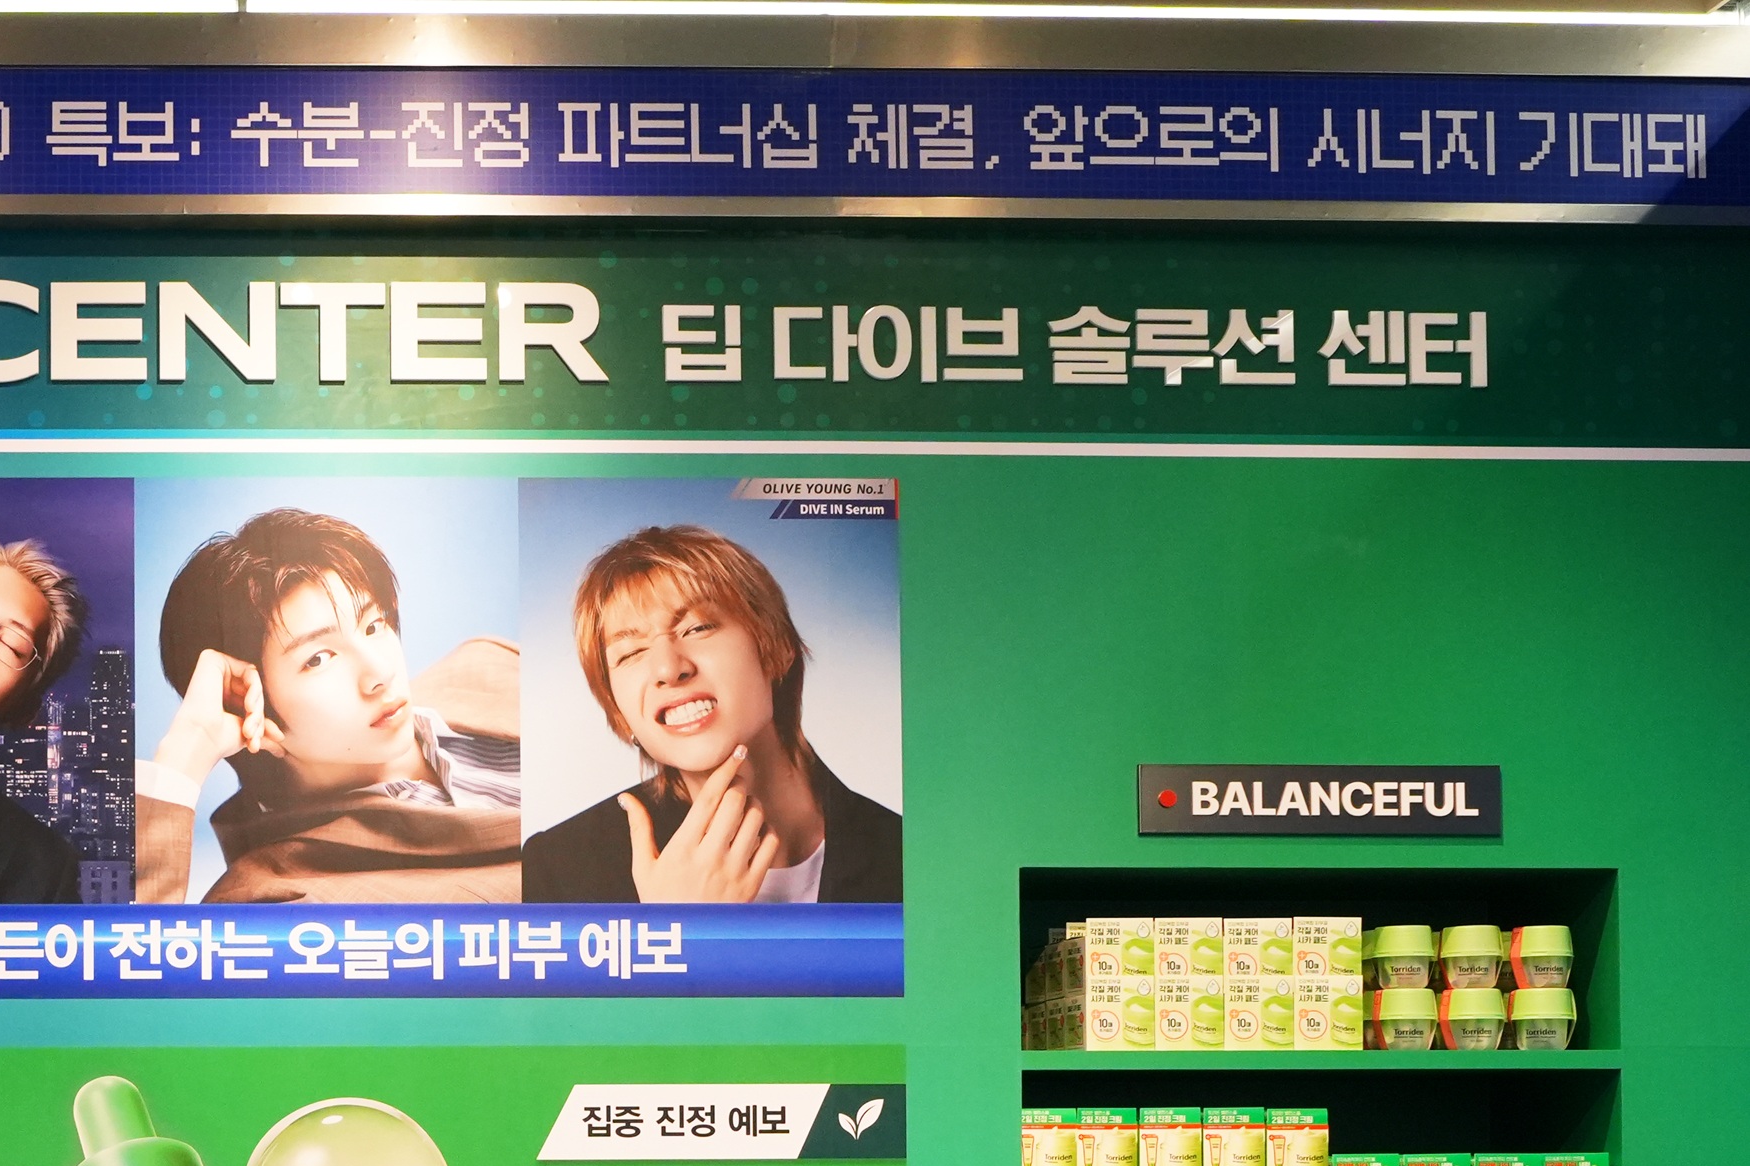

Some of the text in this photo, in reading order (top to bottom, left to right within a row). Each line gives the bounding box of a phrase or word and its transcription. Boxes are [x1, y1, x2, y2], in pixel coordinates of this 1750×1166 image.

[45, 99, 201, 166] 특보:
[229, 99, 529, 167] 수분-진정
[557, 99, 818, 168] 파트너십
[846, 101, 1000, 169] 체결,
[1022, 102, 1280, 172] 앞으로의
[1307, 105, 1495, 175] 시너지
[1517, 109, 1707, 178] 기대돼
[660, 300, 742, 381] 딥
[771, 302, 1024, 382] 다이브
[1046, 302, 1296, 387] 솔루션
[1316, 308, 1489, 388] 센터
[762, 482, 801, 494] OLIVE
[804, 483, 852, 494] YOUNG
[799, 503, 884, 515] DIVE IN Serum
[1190, 779, 1479, 816] BALANCEFUL
[109, 917, 273, 979] 전하는
[283, 916, 443, 979] 오늘의
[458, 917, 567, 980] 피부
[577, 918, 688, 980] 예보
[1389, 963, 1425, 974] Torriden
[581, 1102, 790, 1137] 집중 진정 예보
